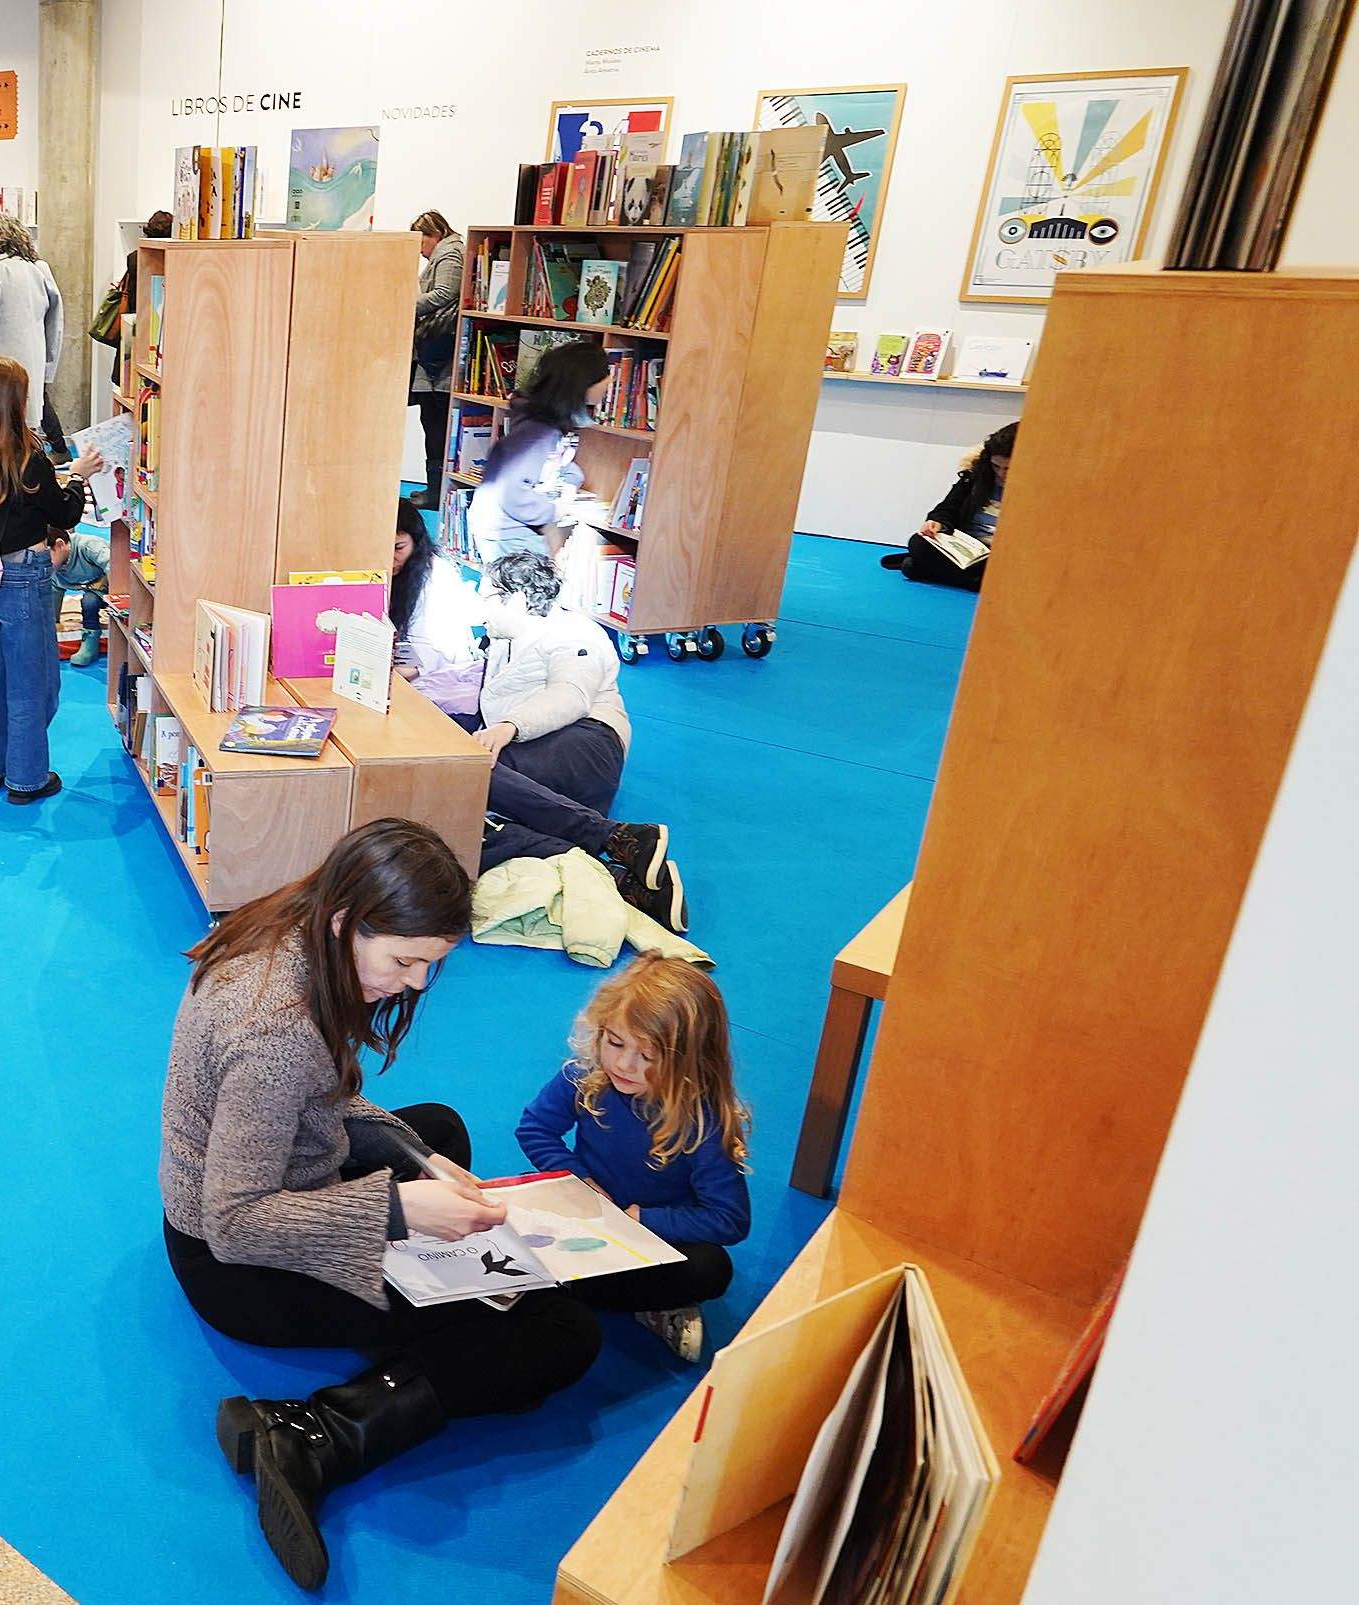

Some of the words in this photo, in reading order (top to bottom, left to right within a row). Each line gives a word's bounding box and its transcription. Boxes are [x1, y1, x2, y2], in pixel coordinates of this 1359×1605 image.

[171, 96, 228, 116] LIBROS
[233, 94, 255, 112] DE
[260, 92, 302, 111] CINE
[382, 104, 455, 120] NOVIDADES
[995, 249, 1111, 270] GATSBY
